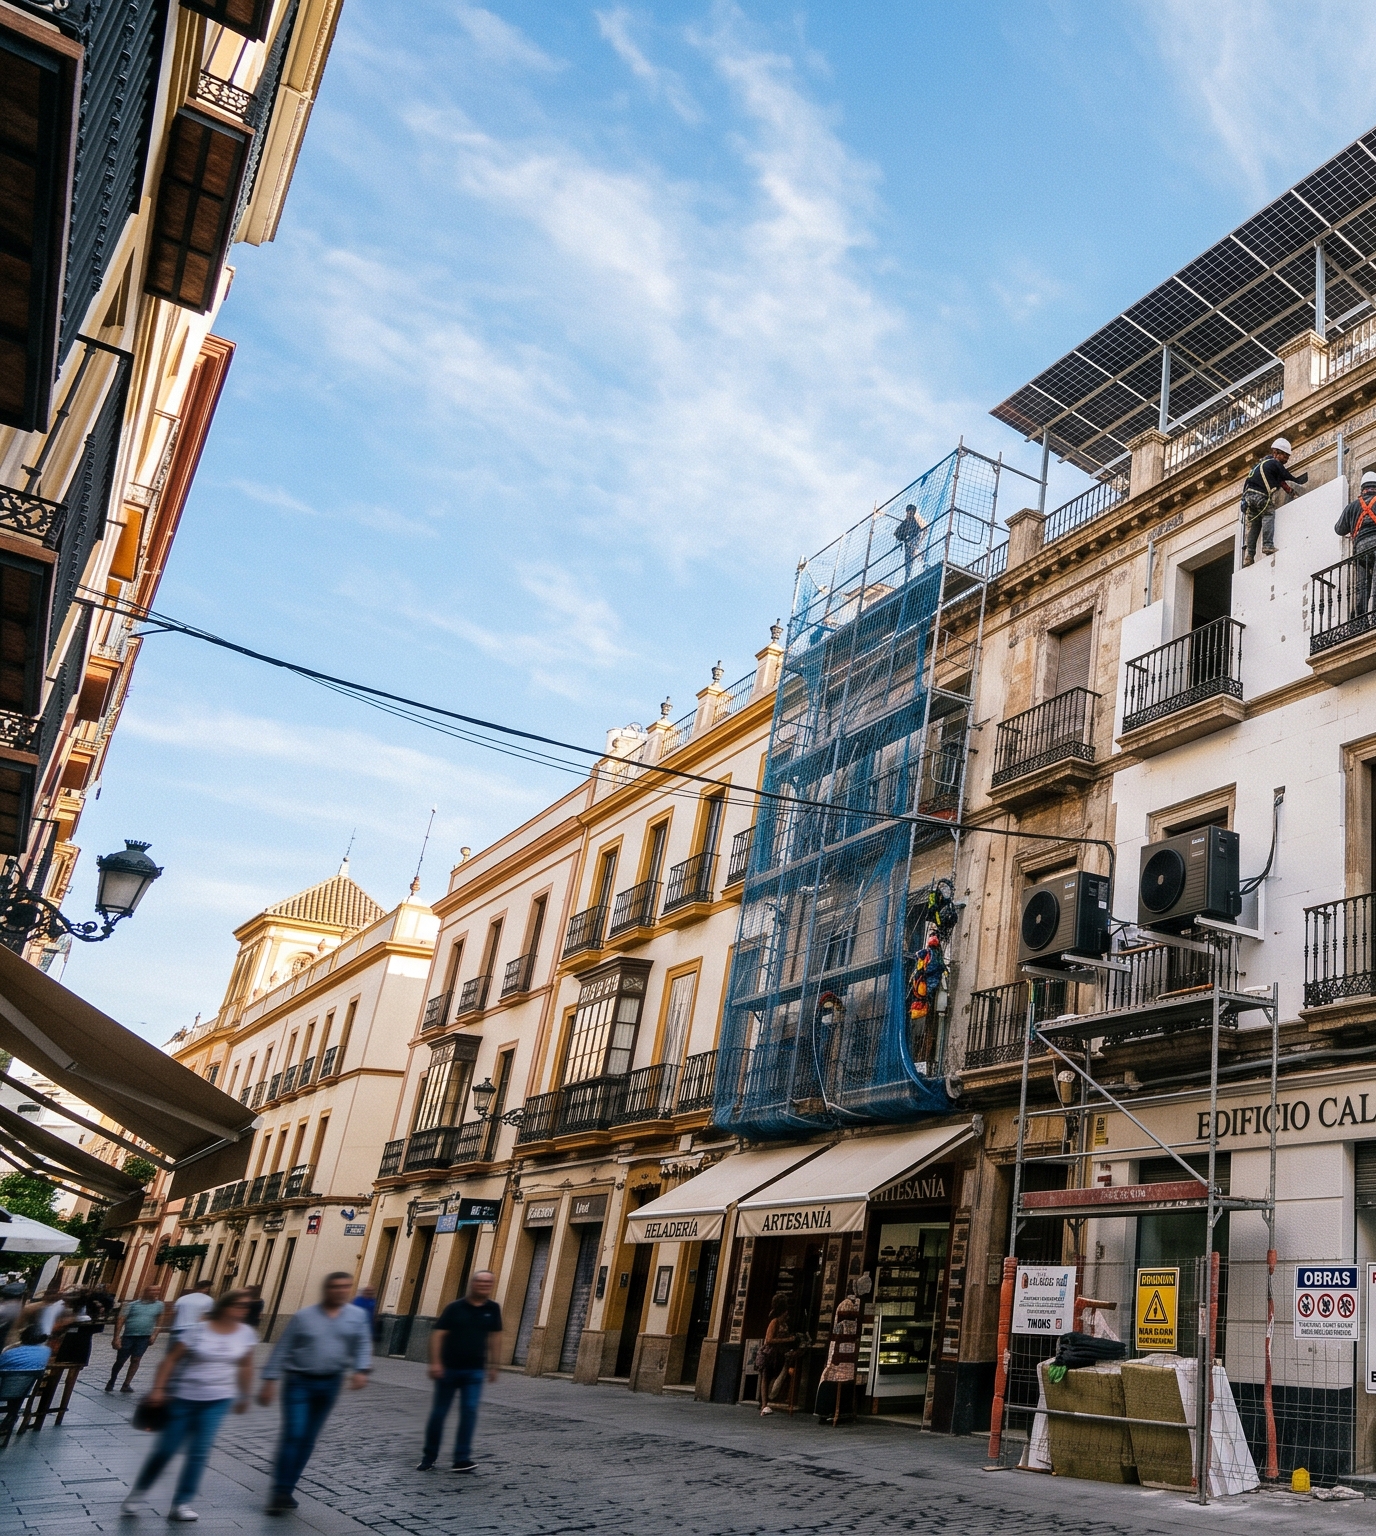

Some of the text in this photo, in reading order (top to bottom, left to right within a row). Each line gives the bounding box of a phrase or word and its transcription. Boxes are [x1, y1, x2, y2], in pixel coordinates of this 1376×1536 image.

[1196, 1101, 1310, 1139] EDIFICIO
[874, 1173, 946, 1202] TESANÍA
[644, 1217, 698, 1238] HELADERÍA
[762, 1206, 831, 1231] ARTESANÍA
[1303, 1271, 1351, 1286] OBRAS
